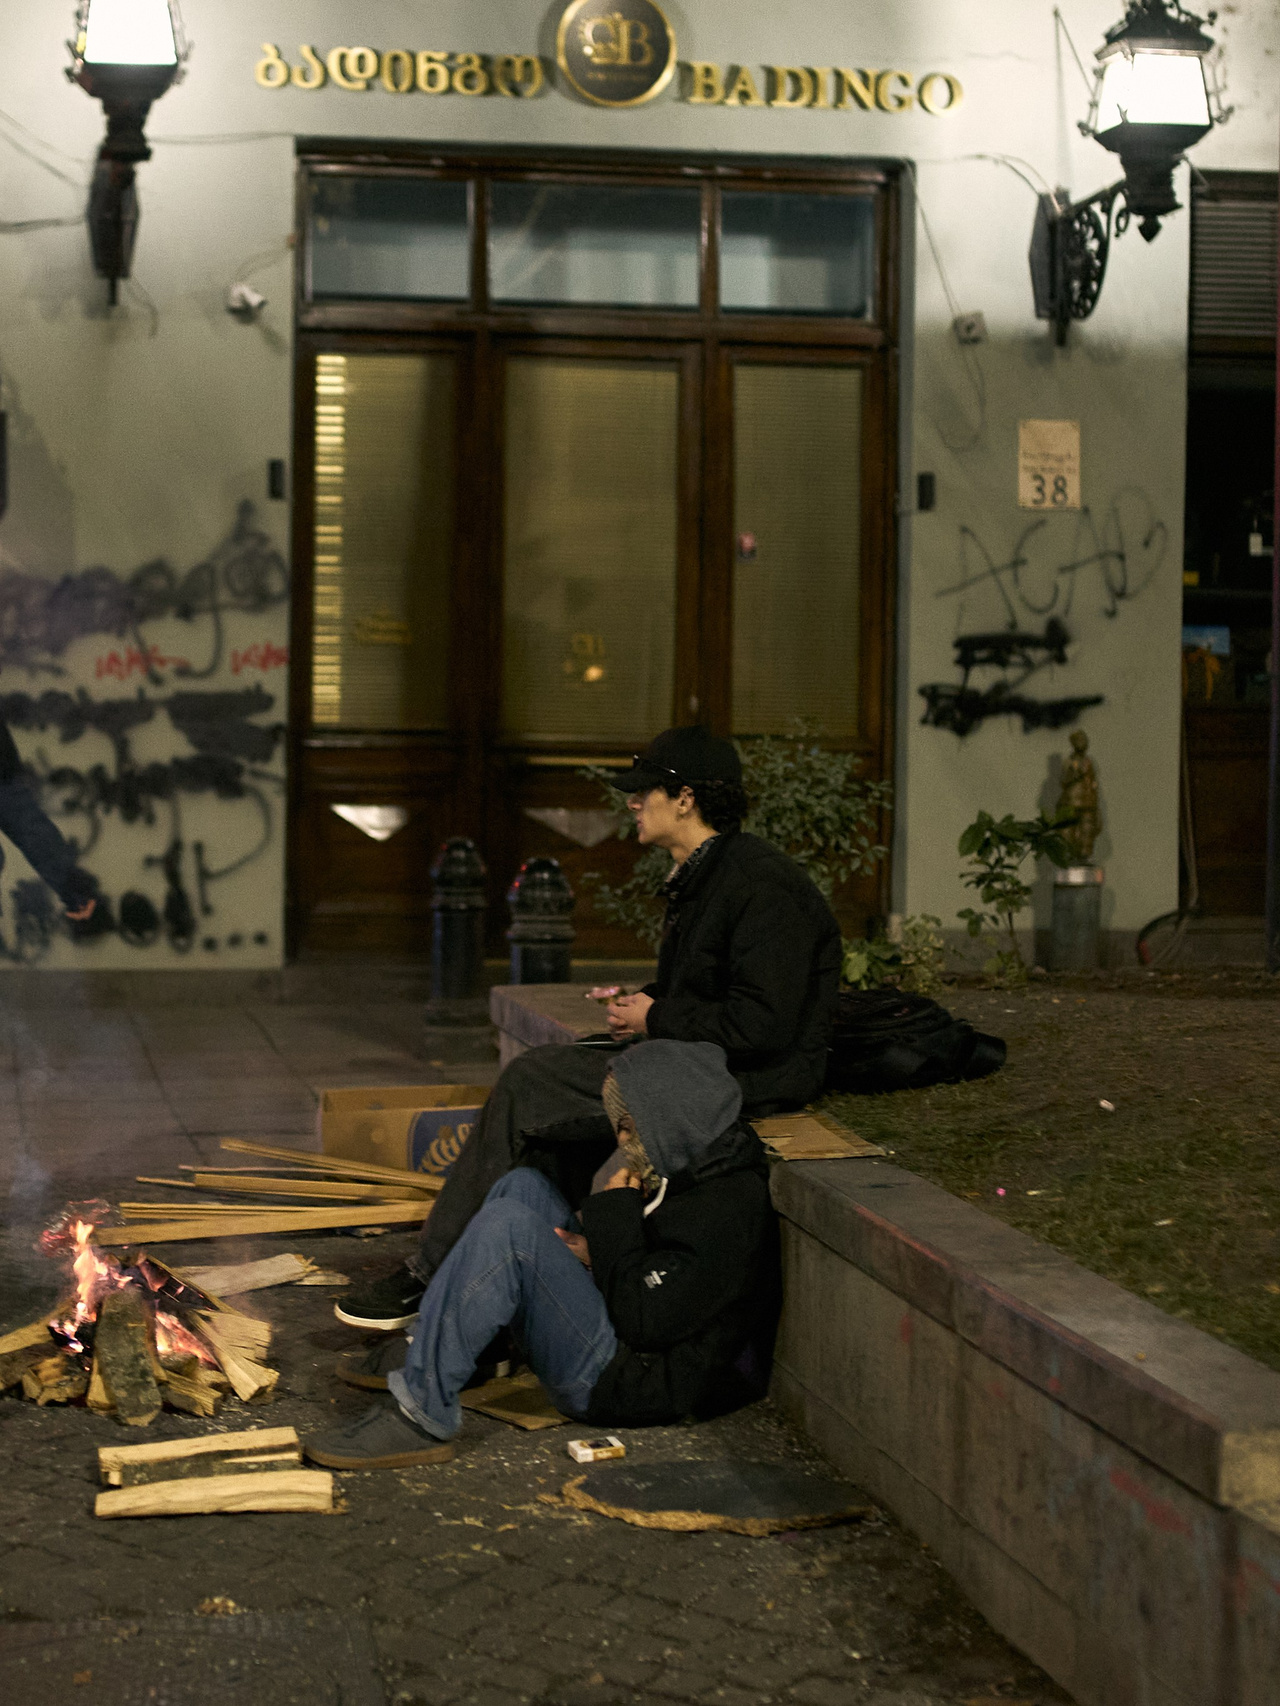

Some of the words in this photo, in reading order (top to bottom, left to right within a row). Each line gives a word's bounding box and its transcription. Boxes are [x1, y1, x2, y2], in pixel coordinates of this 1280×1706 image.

[254, 43, 544, 98] ბადინგო
[686, 60, 964, 117] BADINGO
[1031, 473, 1068, 505] 38
